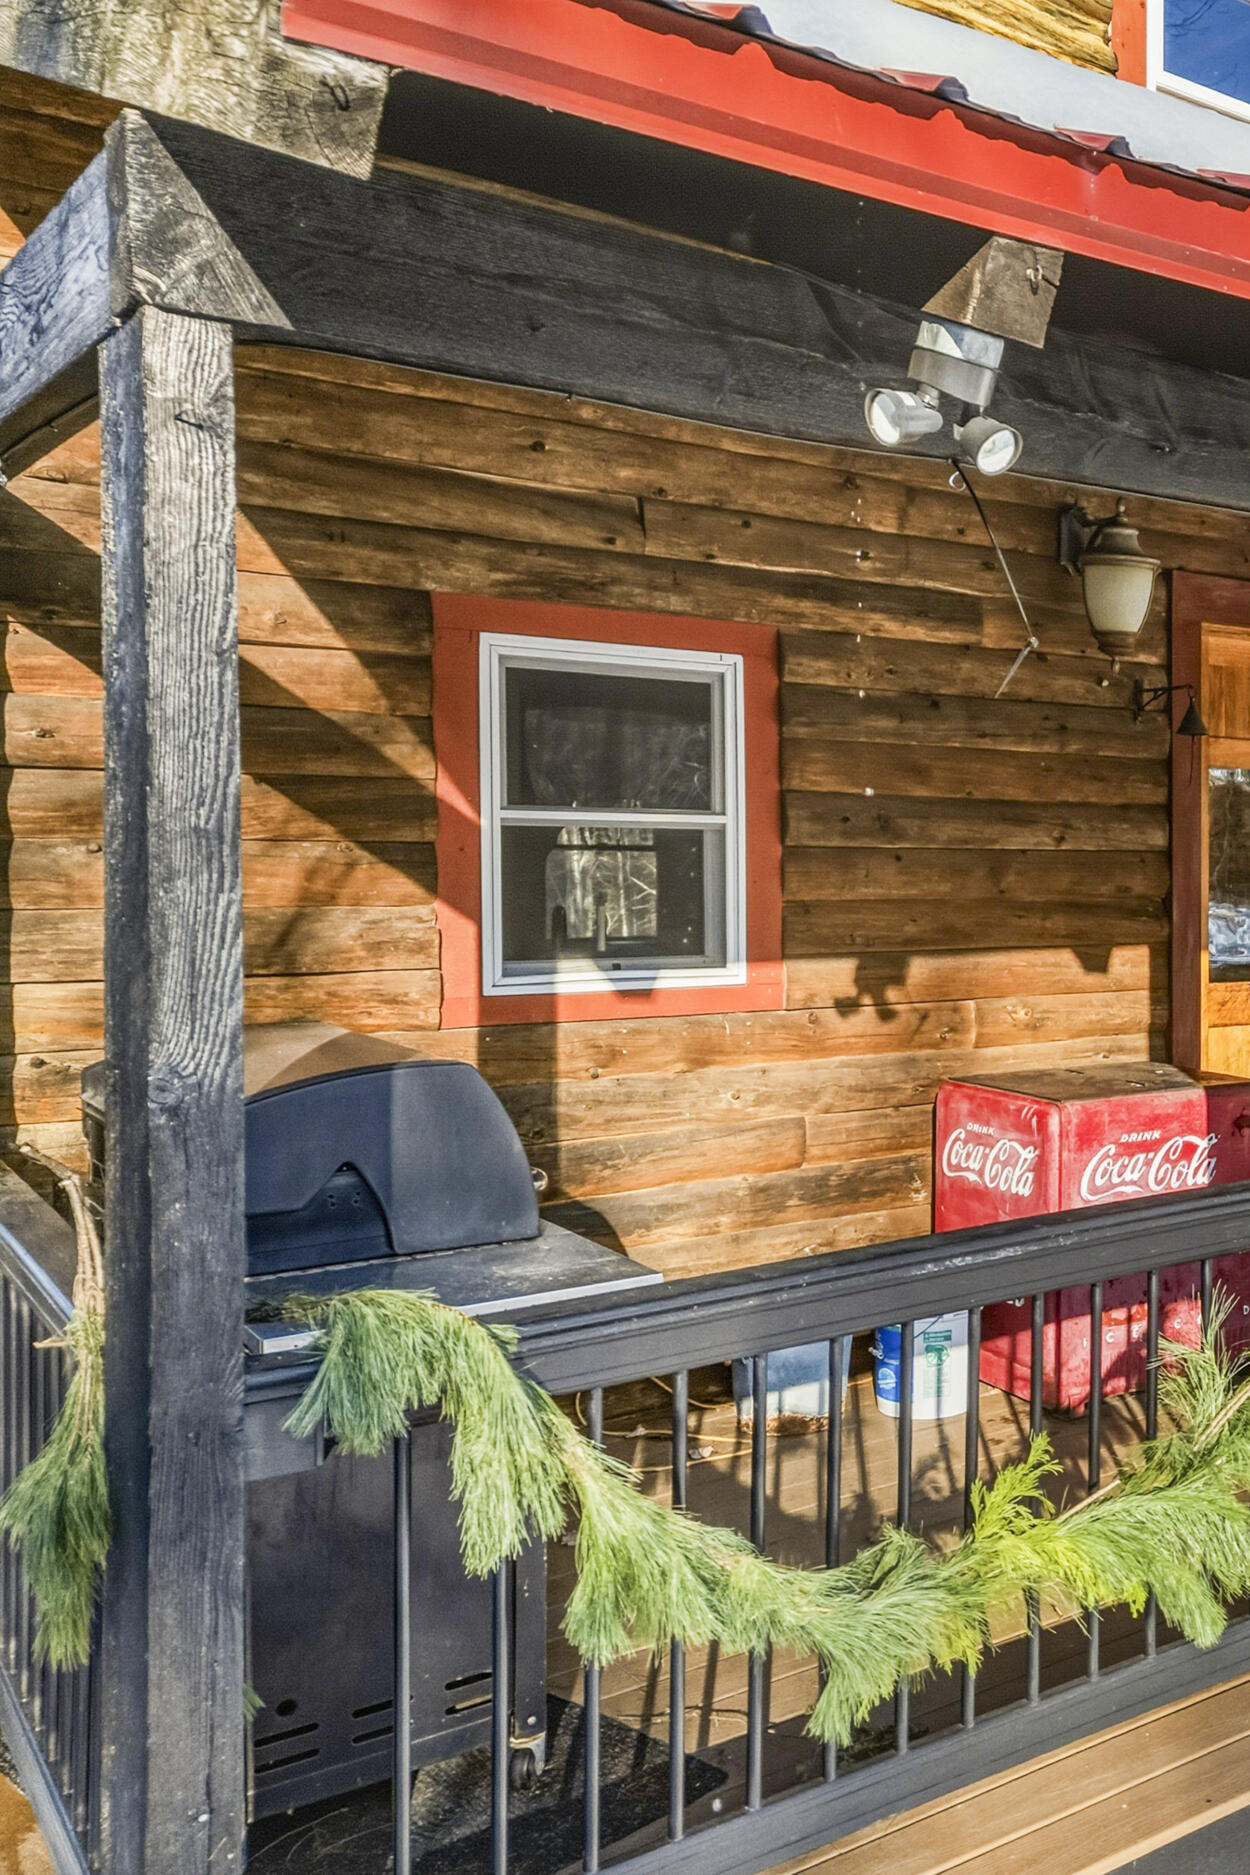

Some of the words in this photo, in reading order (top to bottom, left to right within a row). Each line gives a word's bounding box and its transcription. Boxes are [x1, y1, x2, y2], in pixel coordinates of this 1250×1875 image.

[966, 1122, 996, 1136] DRINK
[1120, 1130, 1162, 1143] DRINK
[942, 1128, 1040, 1198] Coca-Cola
[1080, 1132, 1219, 1202] Coca-Cola
[1173, 1304, 1250, 1330] CD
